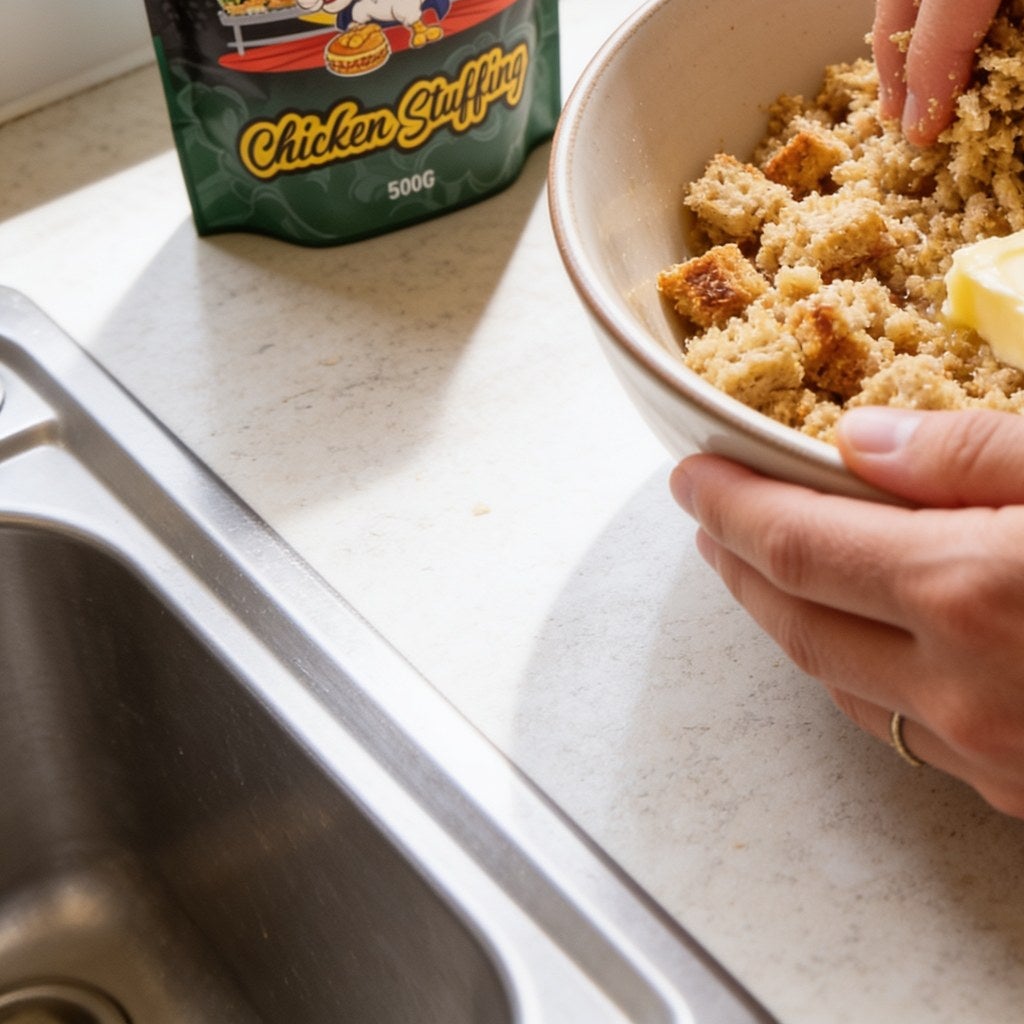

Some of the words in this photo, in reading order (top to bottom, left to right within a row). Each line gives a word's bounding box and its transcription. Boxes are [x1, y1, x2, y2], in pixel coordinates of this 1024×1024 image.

[244, 104, 397, 173] Chicken
[399, 45, 527, 144] Stuffing
[387, 170, 436, 200] 500G
